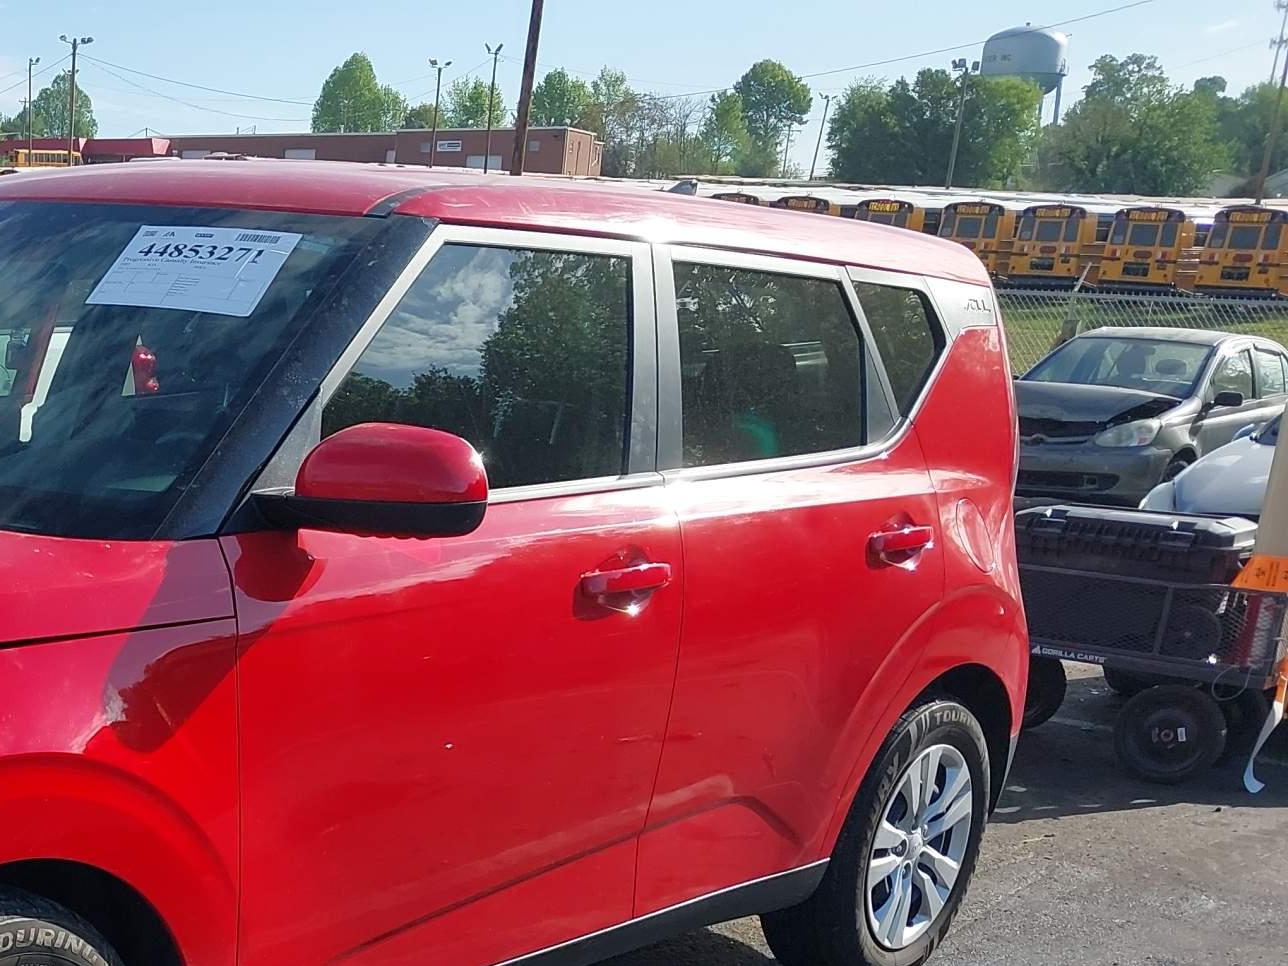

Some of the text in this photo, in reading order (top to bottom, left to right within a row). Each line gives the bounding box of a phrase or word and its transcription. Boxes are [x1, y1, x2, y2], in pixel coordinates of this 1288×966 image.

[138, 242, 265, 265] 44853271
[1041, 647, 1106, 664] GORILLA CARTS
